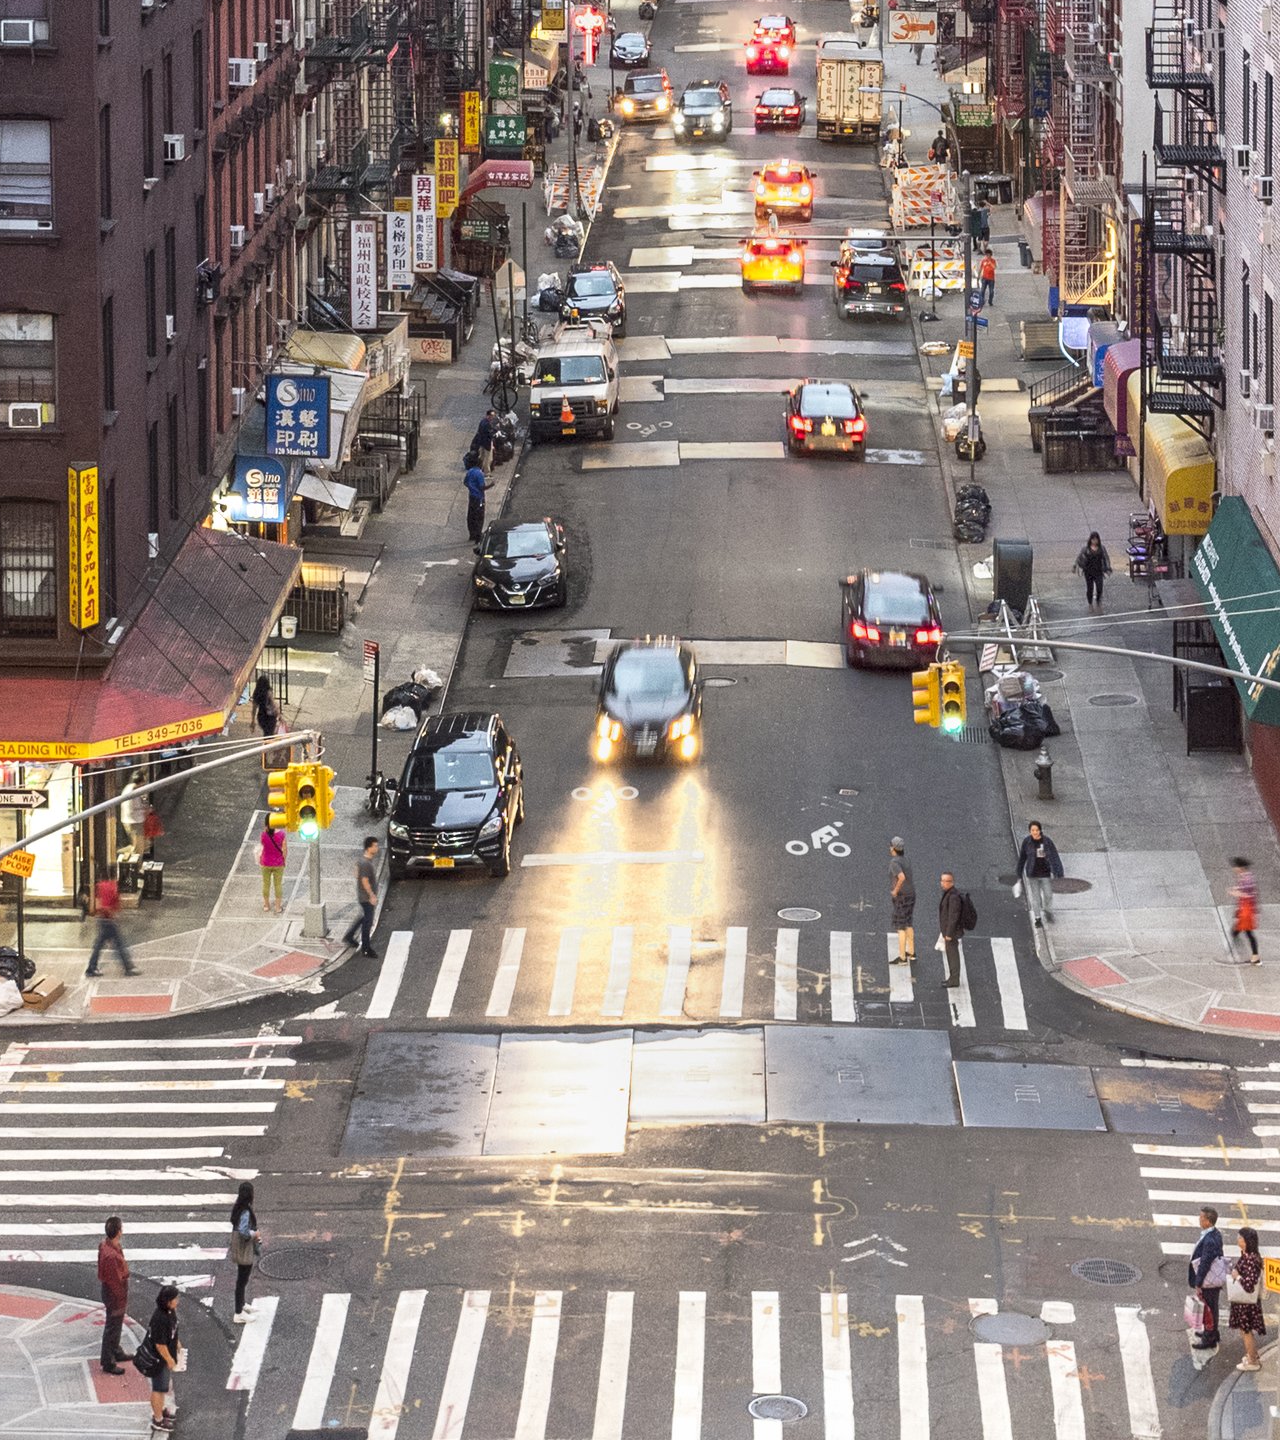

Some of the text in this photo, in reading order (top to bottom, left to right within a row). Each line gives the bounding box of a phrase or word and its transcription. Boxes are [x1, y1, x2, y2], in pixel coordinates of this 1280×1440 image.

[277, 380, 316, 406] Sino
[276, 429, 318, 447] 印刷
[247, 470, 281, 486] Sino
[114, 719, 203, 750] TEL: 349-7036
[55, 745, 81, 756] INC.
[22, 795, 40, 803] WAY
[7, 851, 32, 865] RAISE
[6, 859, 31, 873] PLOW
